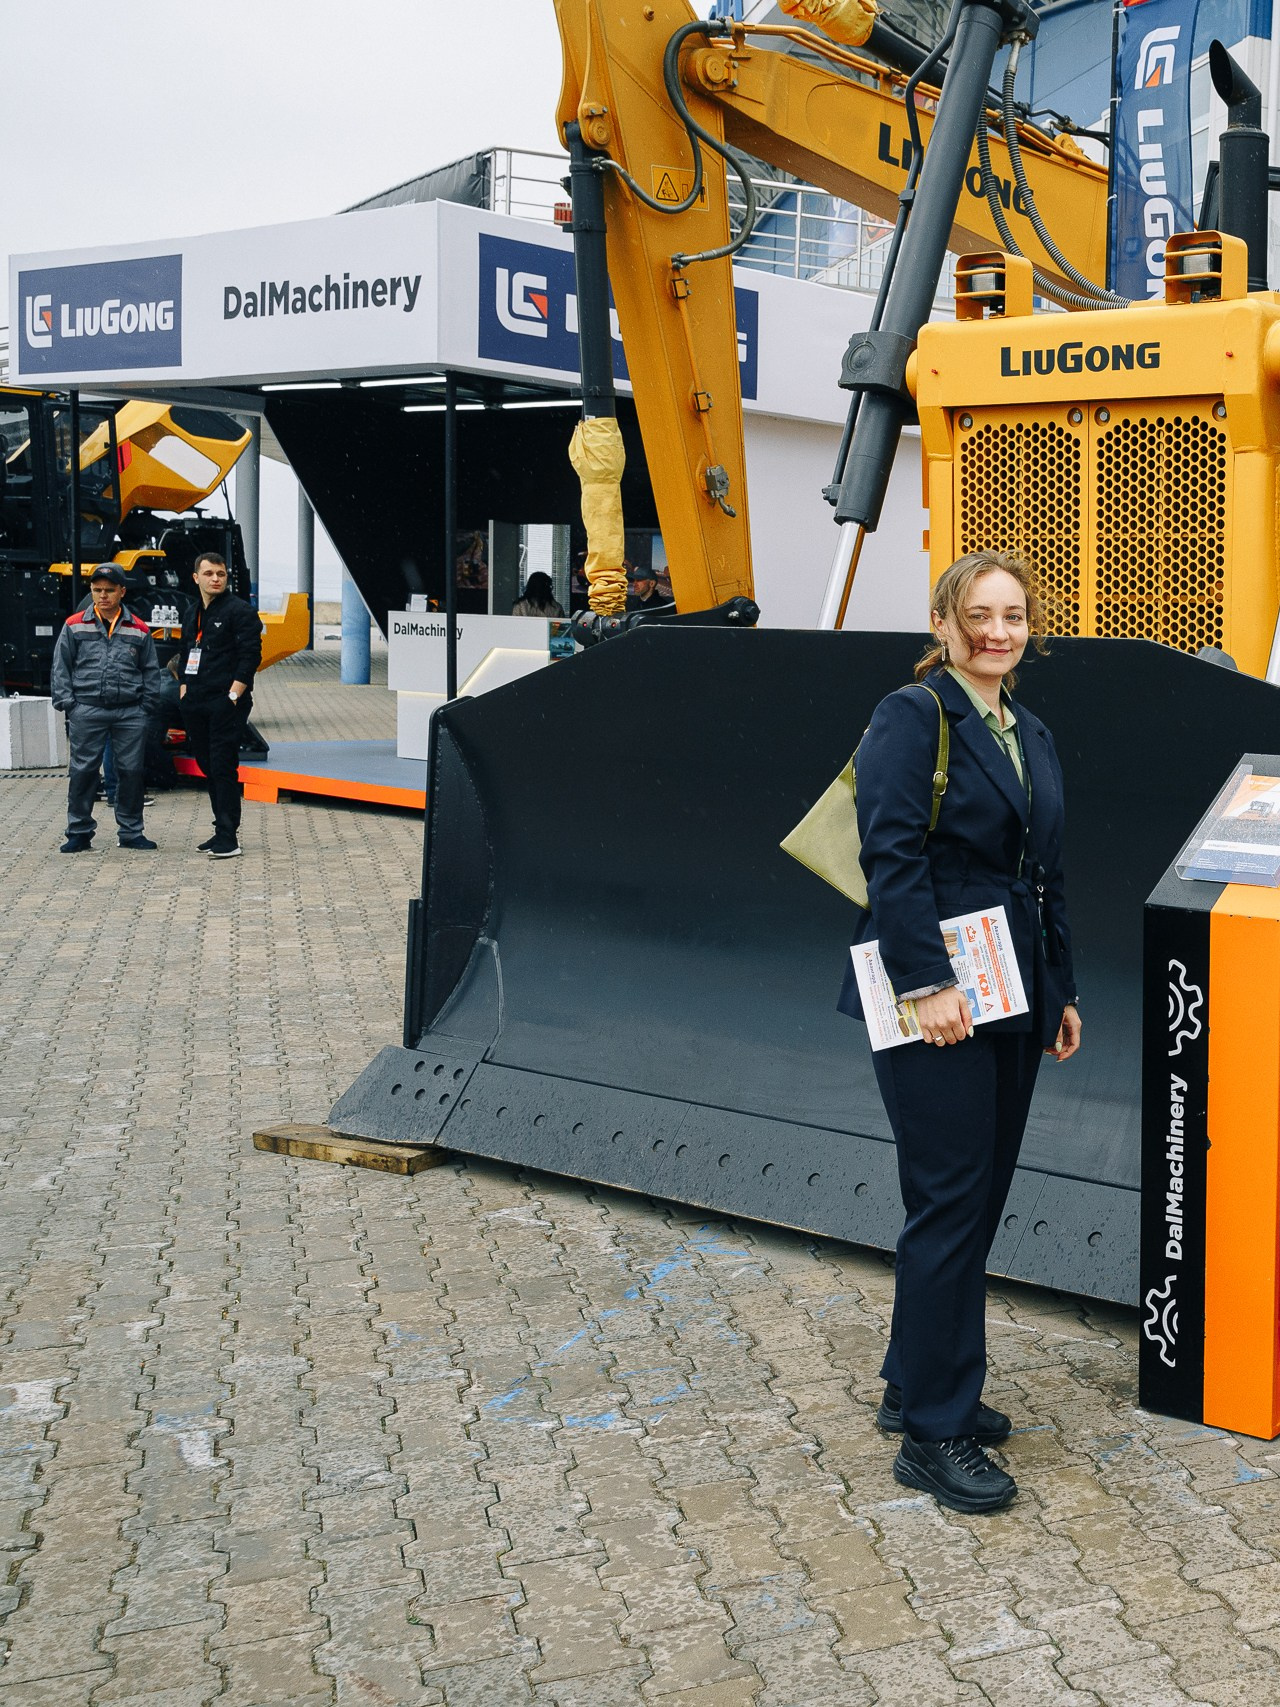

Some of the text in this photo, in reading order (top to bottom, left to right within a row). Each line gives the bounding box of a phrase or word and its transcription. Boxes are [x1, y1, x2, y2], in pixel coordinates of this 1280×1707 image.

[223, 272, 422, 320] DalMachinery
[393, 622, 463, 640] DalMachiny
[1165, 1073, 1188, 1260] DalMachinery
